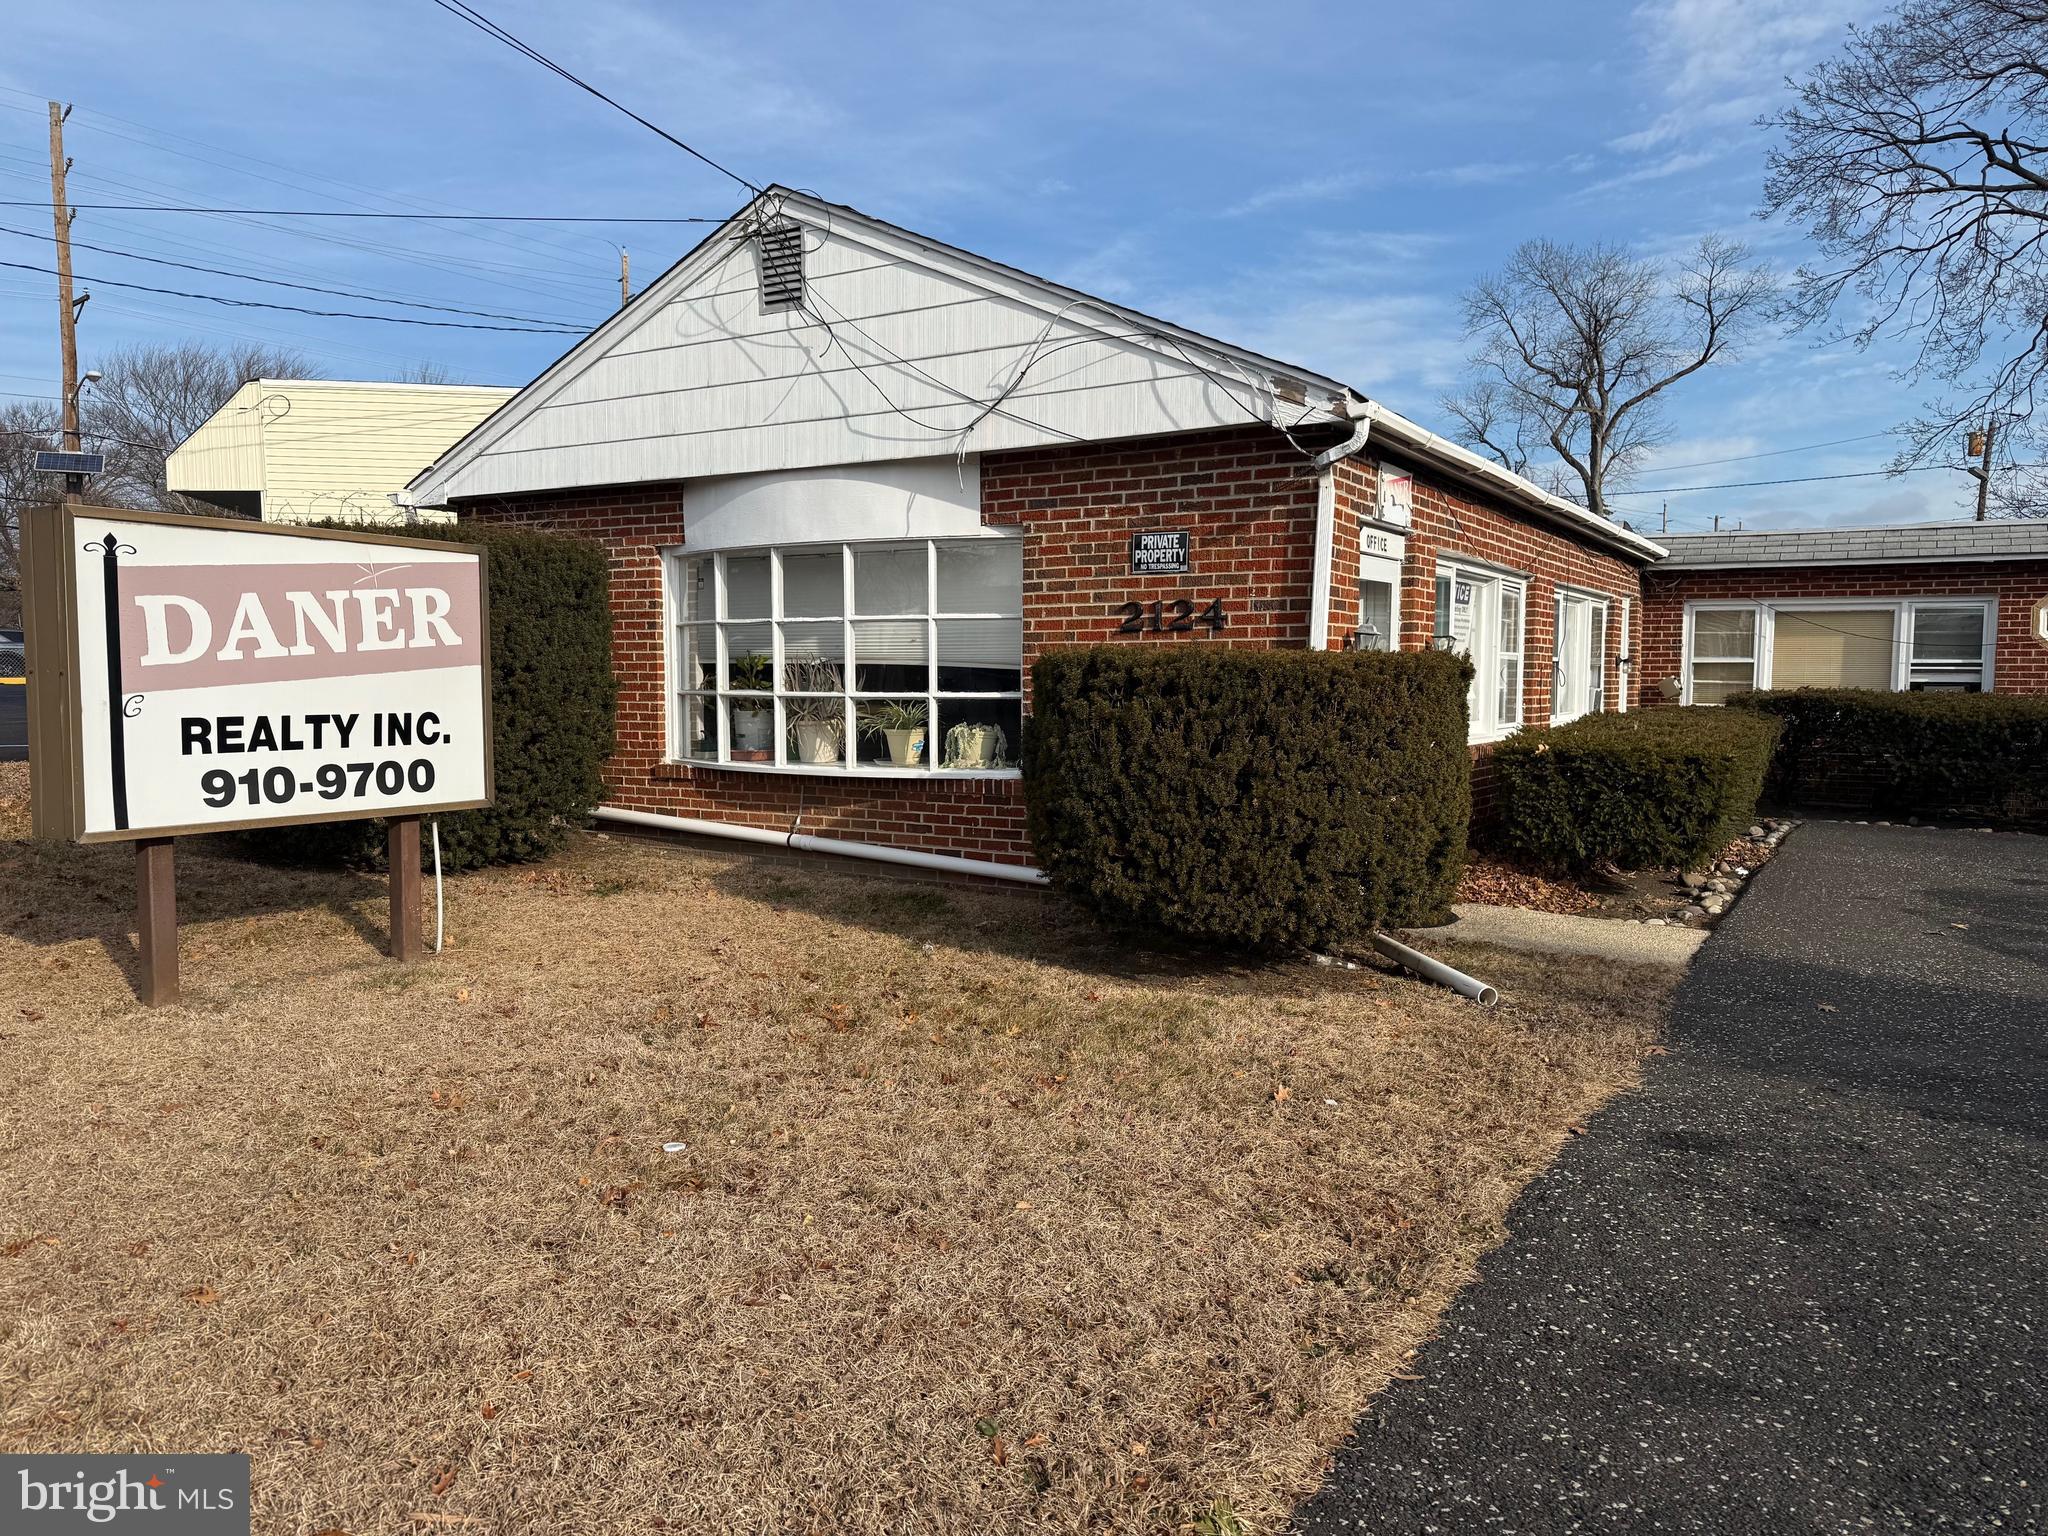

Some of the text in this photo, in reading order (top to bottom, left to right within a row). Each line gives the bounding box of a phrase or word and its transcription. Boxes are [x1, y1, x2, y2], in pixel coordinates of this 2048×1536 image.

[1134, 548, 1185, 563] PROPERTY
[1141, 534, 1180, 550] PRIVATE
[1366, 534, 1388, 552] OFFICE
[134, 586, 463, 668] DANER
[1118, 597, 1228, 633] 2124
[180, 711, 452, 756] REALTY INC.
[200, 758, 436, 808] 910-9700
